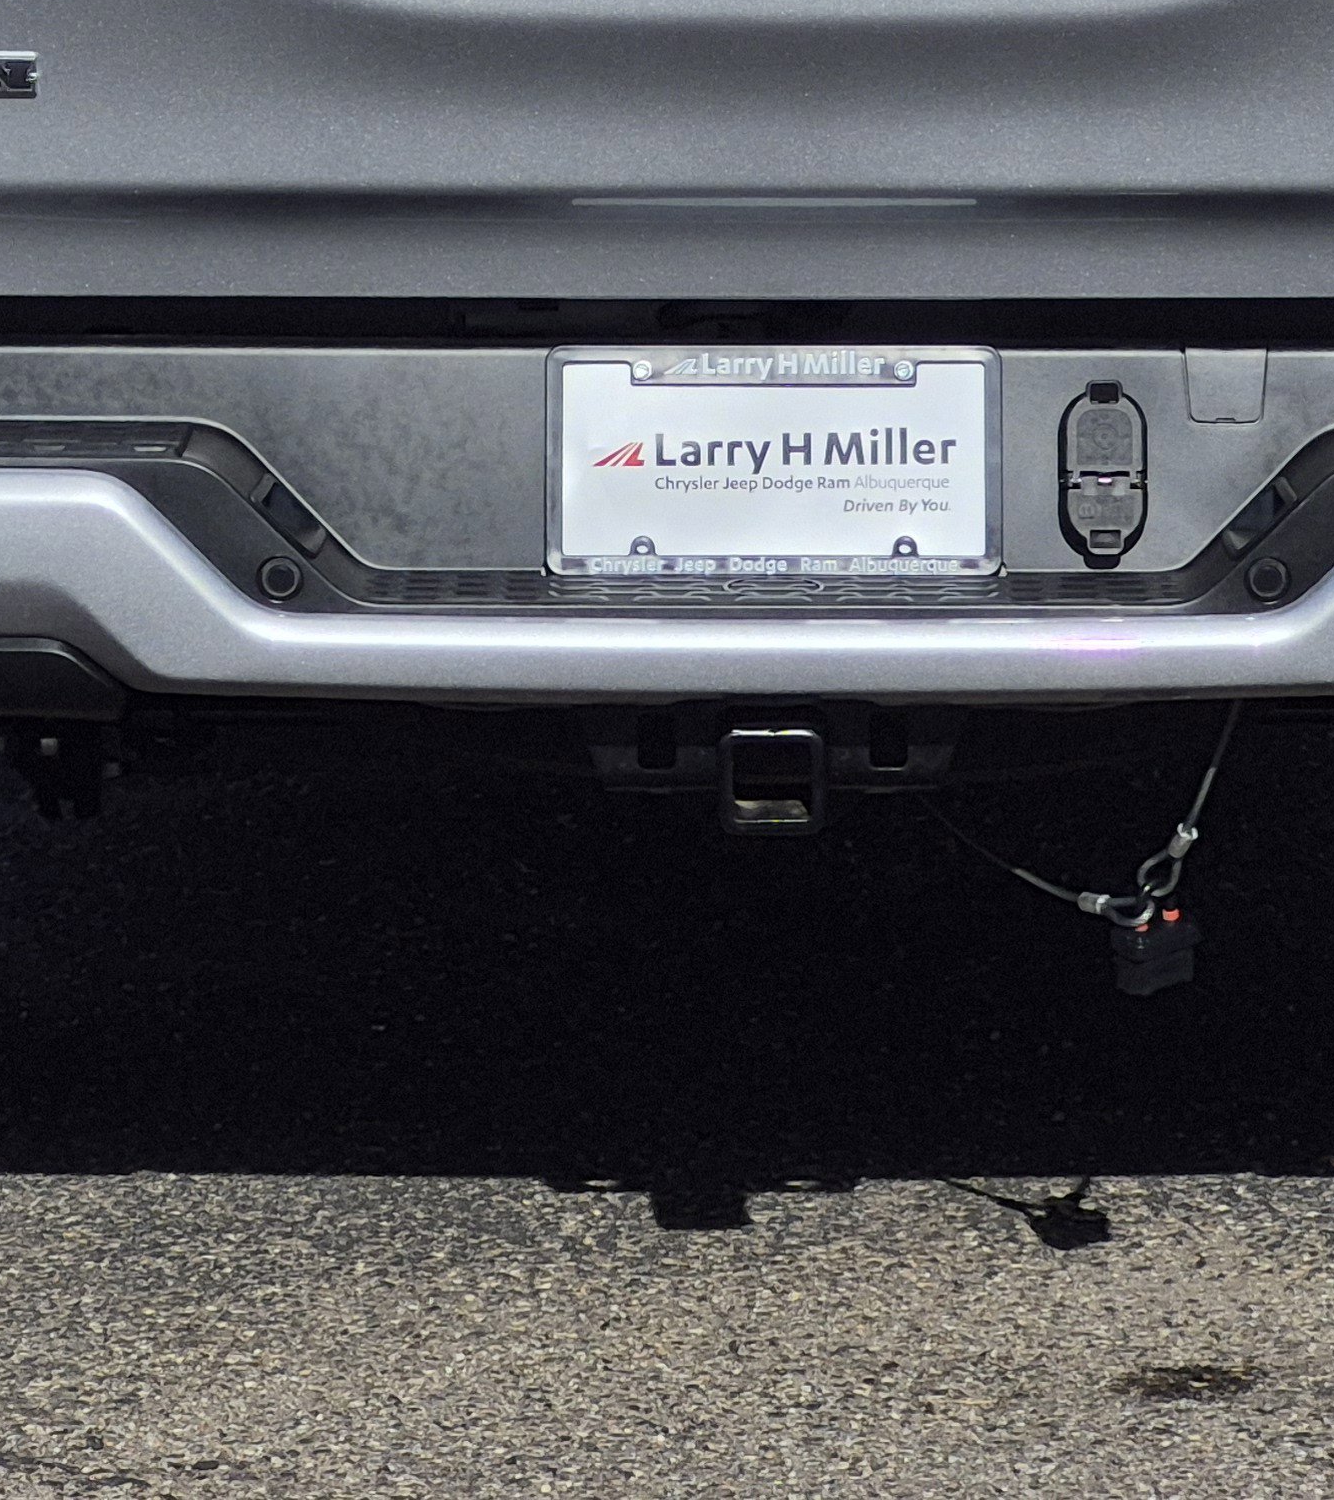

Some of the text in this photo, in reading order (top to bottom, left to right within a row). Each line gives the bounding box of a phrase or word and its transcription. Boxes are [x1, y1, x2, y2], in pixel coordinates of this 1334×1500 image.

[702, 352, 885, 381] Larry H Miller
[655, 427, 957, 474] Larry H Miller
[654, 475, 951, 493] Chrysler Jeep Dodge Ram Albuquerque
[843, 498, 894, 512] Driven
[898, 500, 918, 514] By
[592, 556, 959, 576] Chrysler Jeep Dodge Ram Albuquerque
